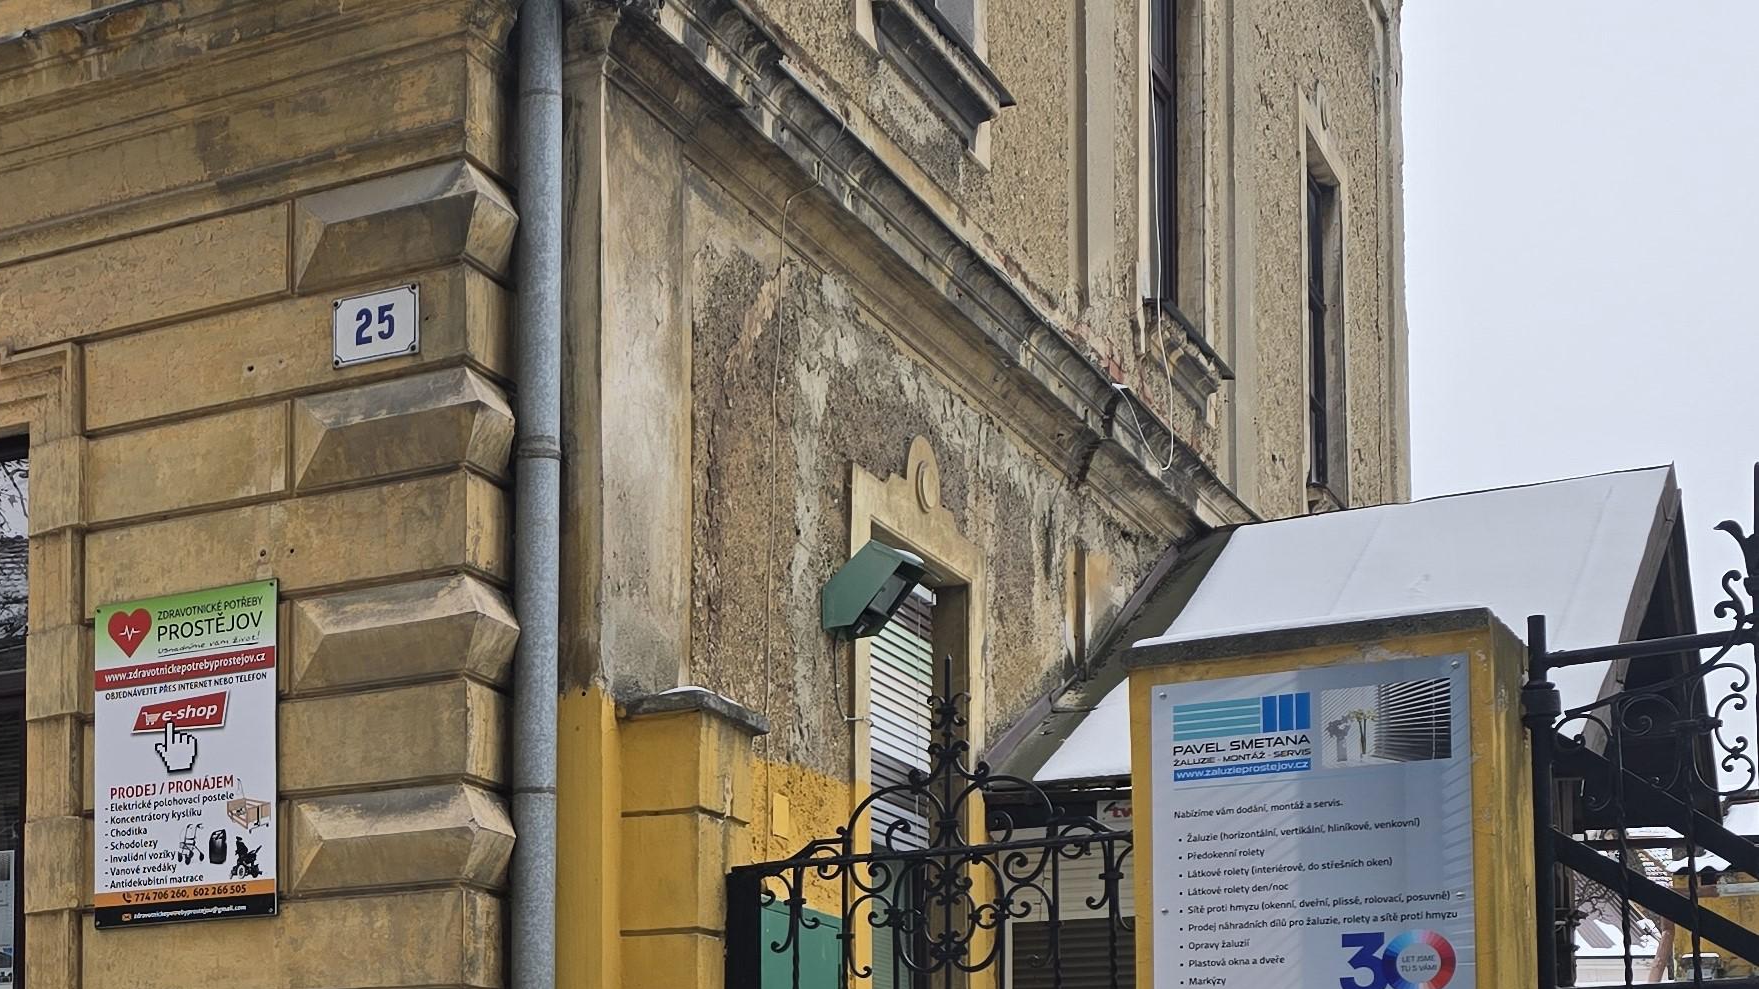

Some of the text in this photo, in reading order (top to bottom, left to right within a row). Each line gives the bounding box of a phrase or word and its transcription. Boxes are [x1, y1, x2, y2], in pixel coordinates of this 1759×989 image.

[356, 302, 394, 346] 25
[157, 596, 263, 620] ZDRAVOTNICKÉ POTŘEBY
[157, 611, 262, 642] PROSTĚJOV
[105, 653, 265, 682] www.zdravotnickepotrebyprostejov.cz
[105, 672, 267, 700] OBJEDNÁVEJTE PŘES INTERNET NEBO TELEFON
[162, 704, 218, 722] e-shop
[1173, 734, 1310, 755] PAVEL SMETANA
[1173, 757, 1215, 766] ŽALUZIE
[1222, 751, 1265, 762] MONTÁŽ
[1273, 748, 1311, 757] SERVIS
[1176, 761, 1309, 779] www.zaluzieprostejov.cz
[110, 783, 156, 799] PRODEJ
[168, 775, 234, 792] PRONÁJEM
[110, 799, 151, 811] Elektrické
[153, 795, 200, 808] polohovací
[202, 792, 234, 804] postele
[1173, 809, 1214, 818] Nabízíme
[1215, 807, 1234, 815] vám
[1236, 803, 1268, 814] dodání,
[1270, 800, 1304, 811] montáž
[1313, 799, 1343, 808] servis.
[110, 812, 170, 824] Koncentrátory
[171, 807, 202, 820] kyslíku
[110, 826, 147, 837] Chodítka
[1186, 817, 1420, 842] Žaluzie (horizontální, vertikální, hliníkové, venkovní)
[110, 839, 158, 850] Schodolezy
[1187, 848, 1265, 859] Předokenní rolety
[110, 852, 146, 862] Invalidní
[148, 850, 176, 862] vozíky
[109, 865, 140, 875] Vanové
[142, 862, 177, 873] zvedáky
[1187, 856, 1392, 878] Látkové rolety (interiérové, do střešních oken)
[109, 875, 167, 889] Antidekubitní
[169, 874, 203, 884] matrace
[1187, 883, 1288, 895] Látkové rolety den/noc
[134, 892, 150, 901] 774
[152, 890, 168, 900] 706
[193, 888, 209, 896] 602
[211, 886, 228, 895] 266
[229, 884, 246, 894] 505
[1187, 890, 1450, 914] Sítě proti hmyzu (okenní, dveřní, plissé, rolovací, posuvné)
[1188, 922, 1216, 932] Prodej
[1218, 919, 1268, 929] náhradních
[1269, 918, 1286, 927] dílů
[1288, 919, 1304, 928] pro
[1305, 916, 1340, 925] žaluzie,
[1342, 914, 1370, 923] rolety
[1379, 912, 1398, 921] sítě
[1400, 911, 1423, 922] proti
[1425, 911, 1457, 919] hmyzu
[1188, 938, 1250, 950] Opravy žaluzií
[1188, 958, 1226, 967] Plastová
[1228, 957, 1250, 965] okna
[1259, 955, 1285, 964] dveře
[1188, 976, 1226, 985] Markýzy
